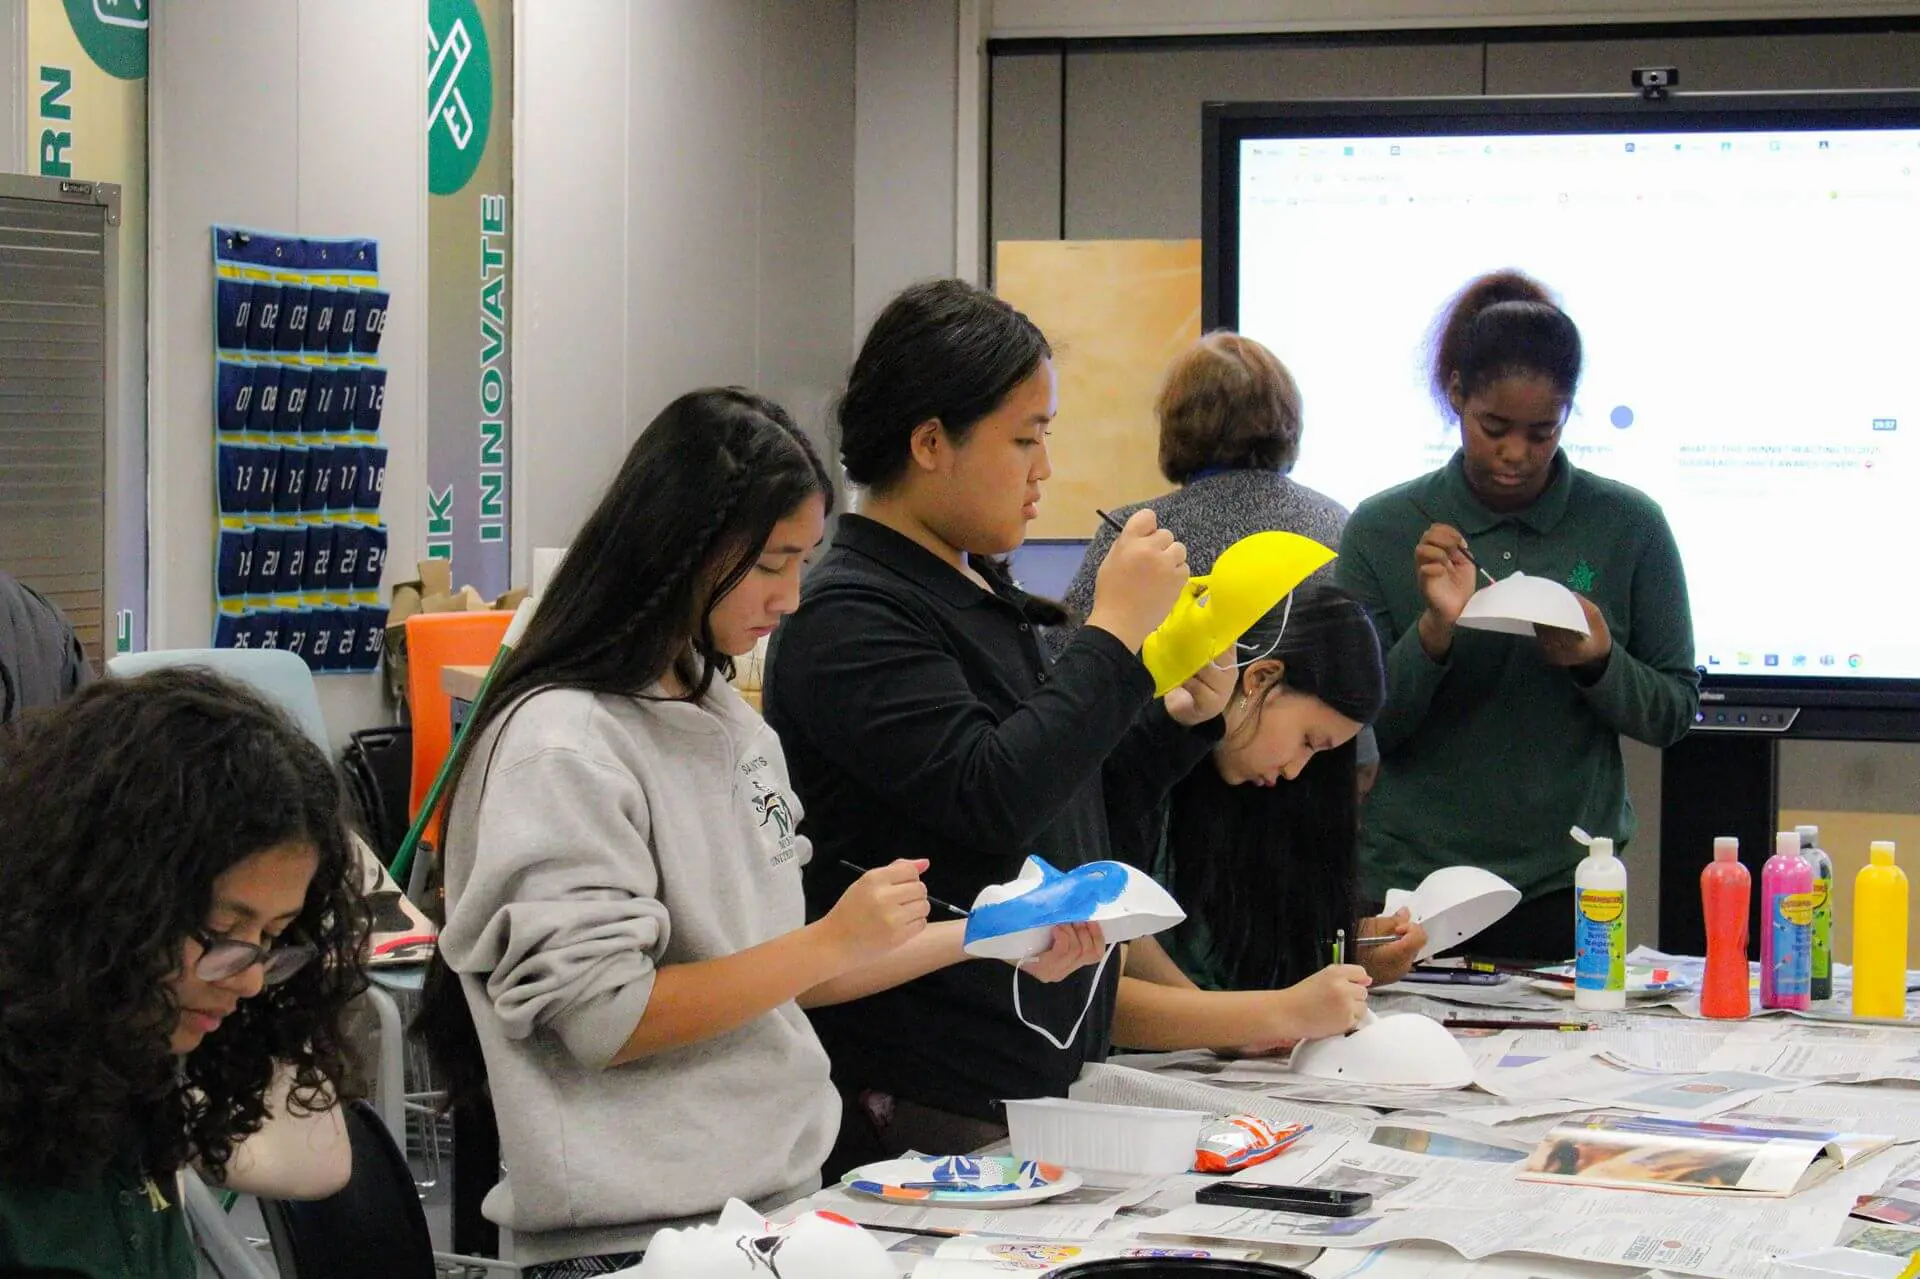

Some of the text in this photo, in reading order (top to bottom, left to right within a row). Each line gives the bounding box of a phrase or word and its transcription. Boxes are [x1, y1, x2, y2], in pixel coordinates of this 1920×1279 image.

[260, 304, 279, 329] 02
[289, 305, 308, 331] 03
[480, 195, 506, 543] INNOVATE
[260, 386, 278, 411] 08
[287, 387, 307, 413] 09
[342, 385, 358, 411] 11
[236, 466, 253, 491] 13
[288, 469, 304, 494] 15
[315, 468, 331, 493] 16
[340, 466, 357, 490] 17
[367, 466, 385, 491] 18
[238, 547, 386, 576] 19 20 21 22 23 24
[365, 627, 385, 652] 30
